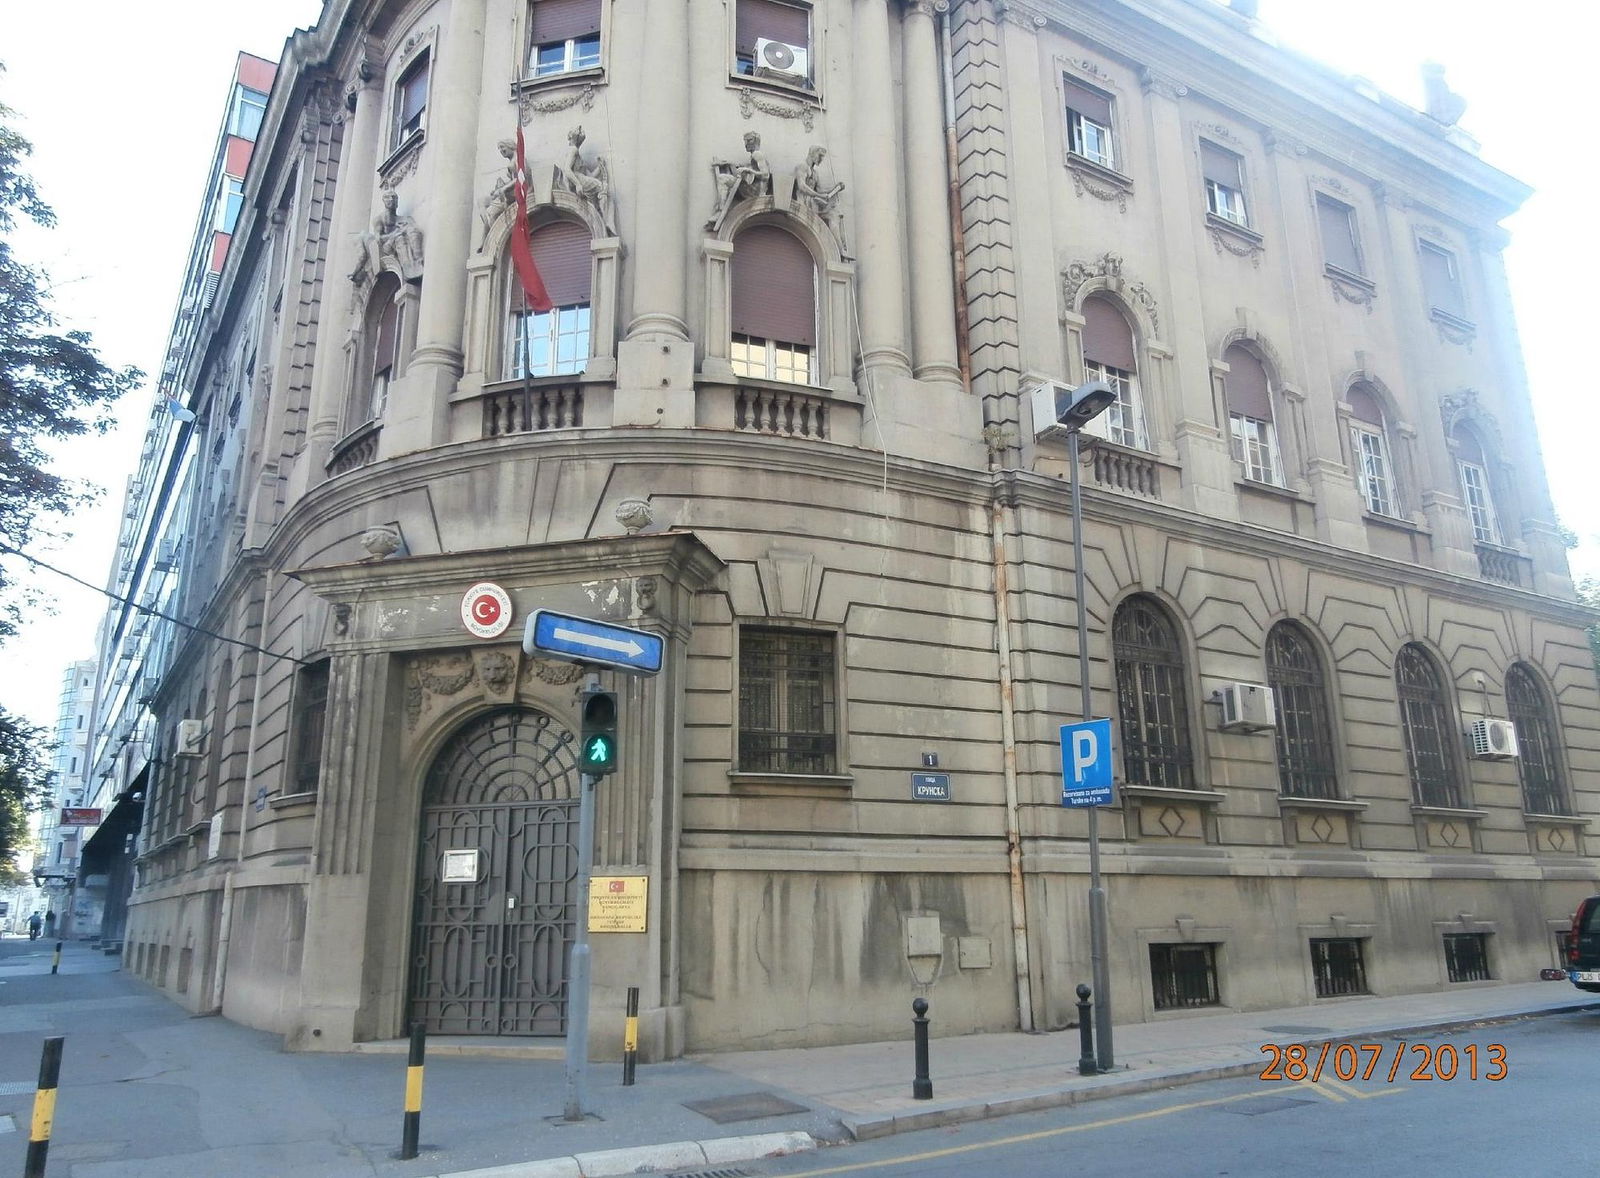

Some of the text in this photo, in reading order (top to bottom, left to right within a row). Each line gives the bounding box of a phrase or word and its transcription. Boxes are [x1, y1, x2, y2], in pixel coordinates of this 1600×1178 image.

[928, 755, 933, 765] 1
[1072, 729, 1098, 782] P
[917, 785, 945, 796] КРУНСКА
